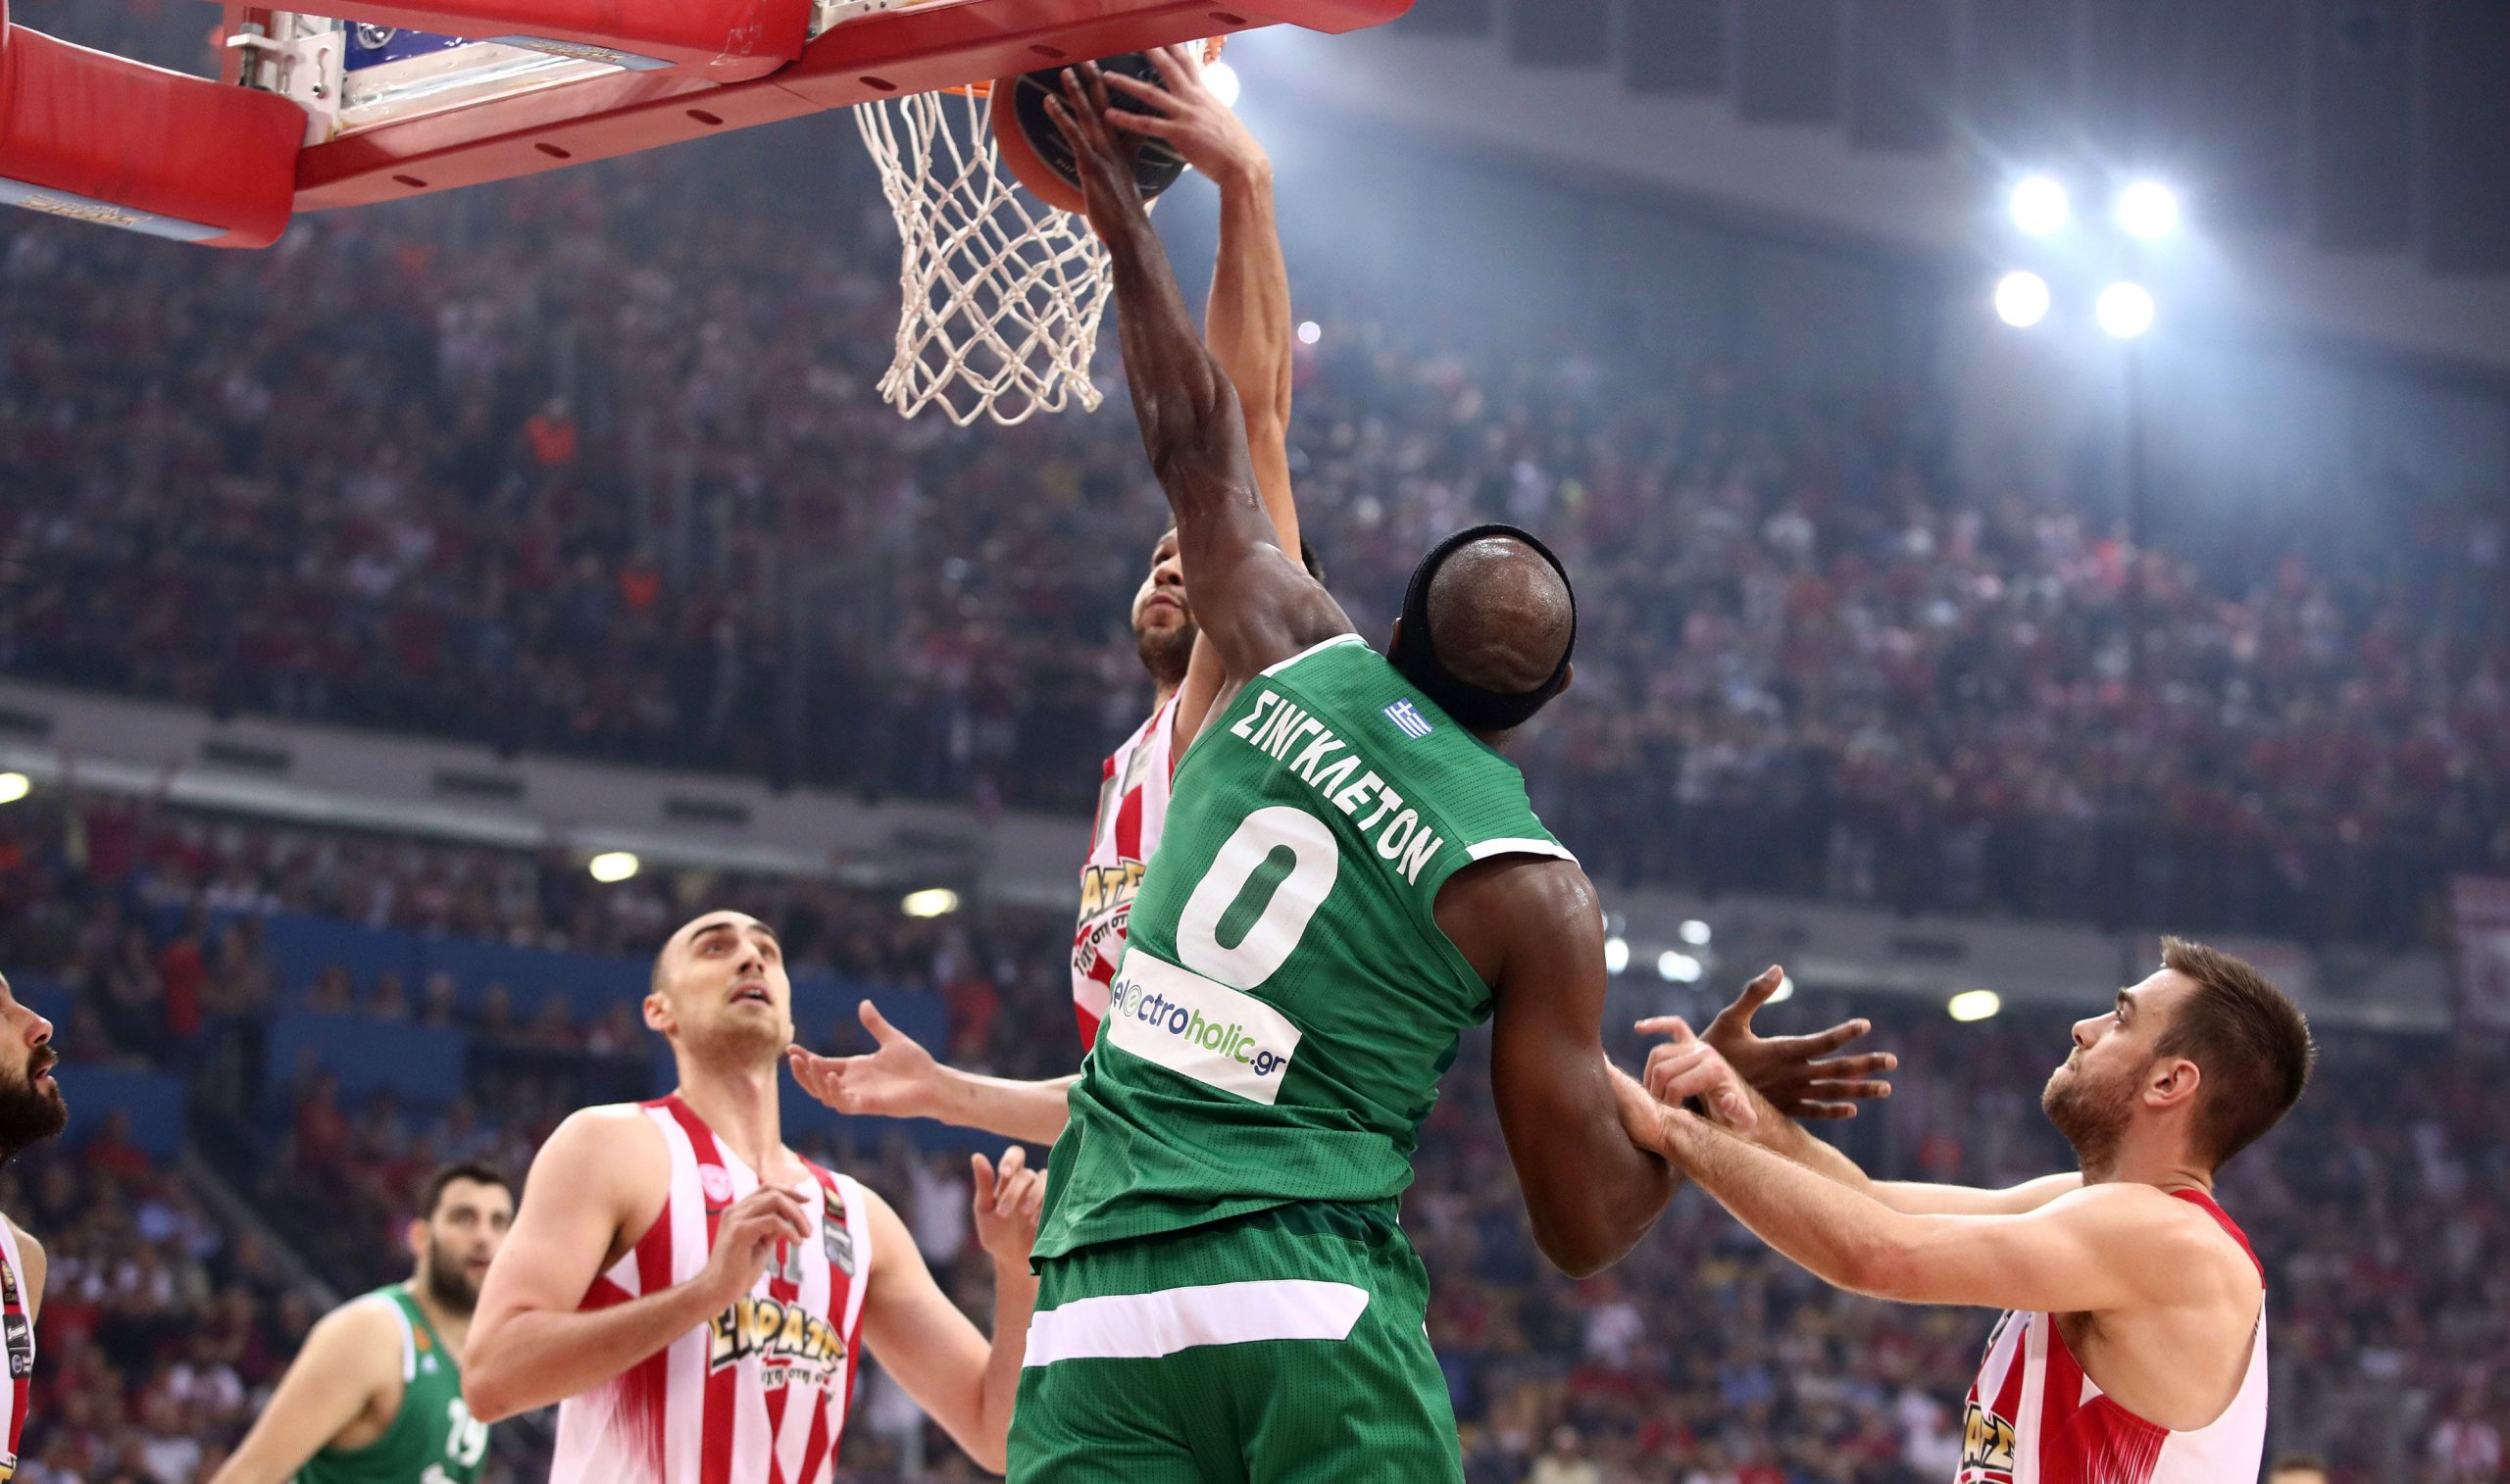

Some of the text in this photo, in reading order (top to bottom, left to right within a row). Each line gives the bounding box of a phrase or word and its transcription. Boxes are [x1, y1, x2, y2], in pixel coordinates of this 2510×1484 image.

[1230, 689, 1444, 887] ΣΙΝΓΚΛΕΤΟΝ
[1079, 859, 1146, 930] ΑΤΣ
[1177, 806, 1339, 991] 0
[1113, 979, 1286, 1076] electroholic.gr
